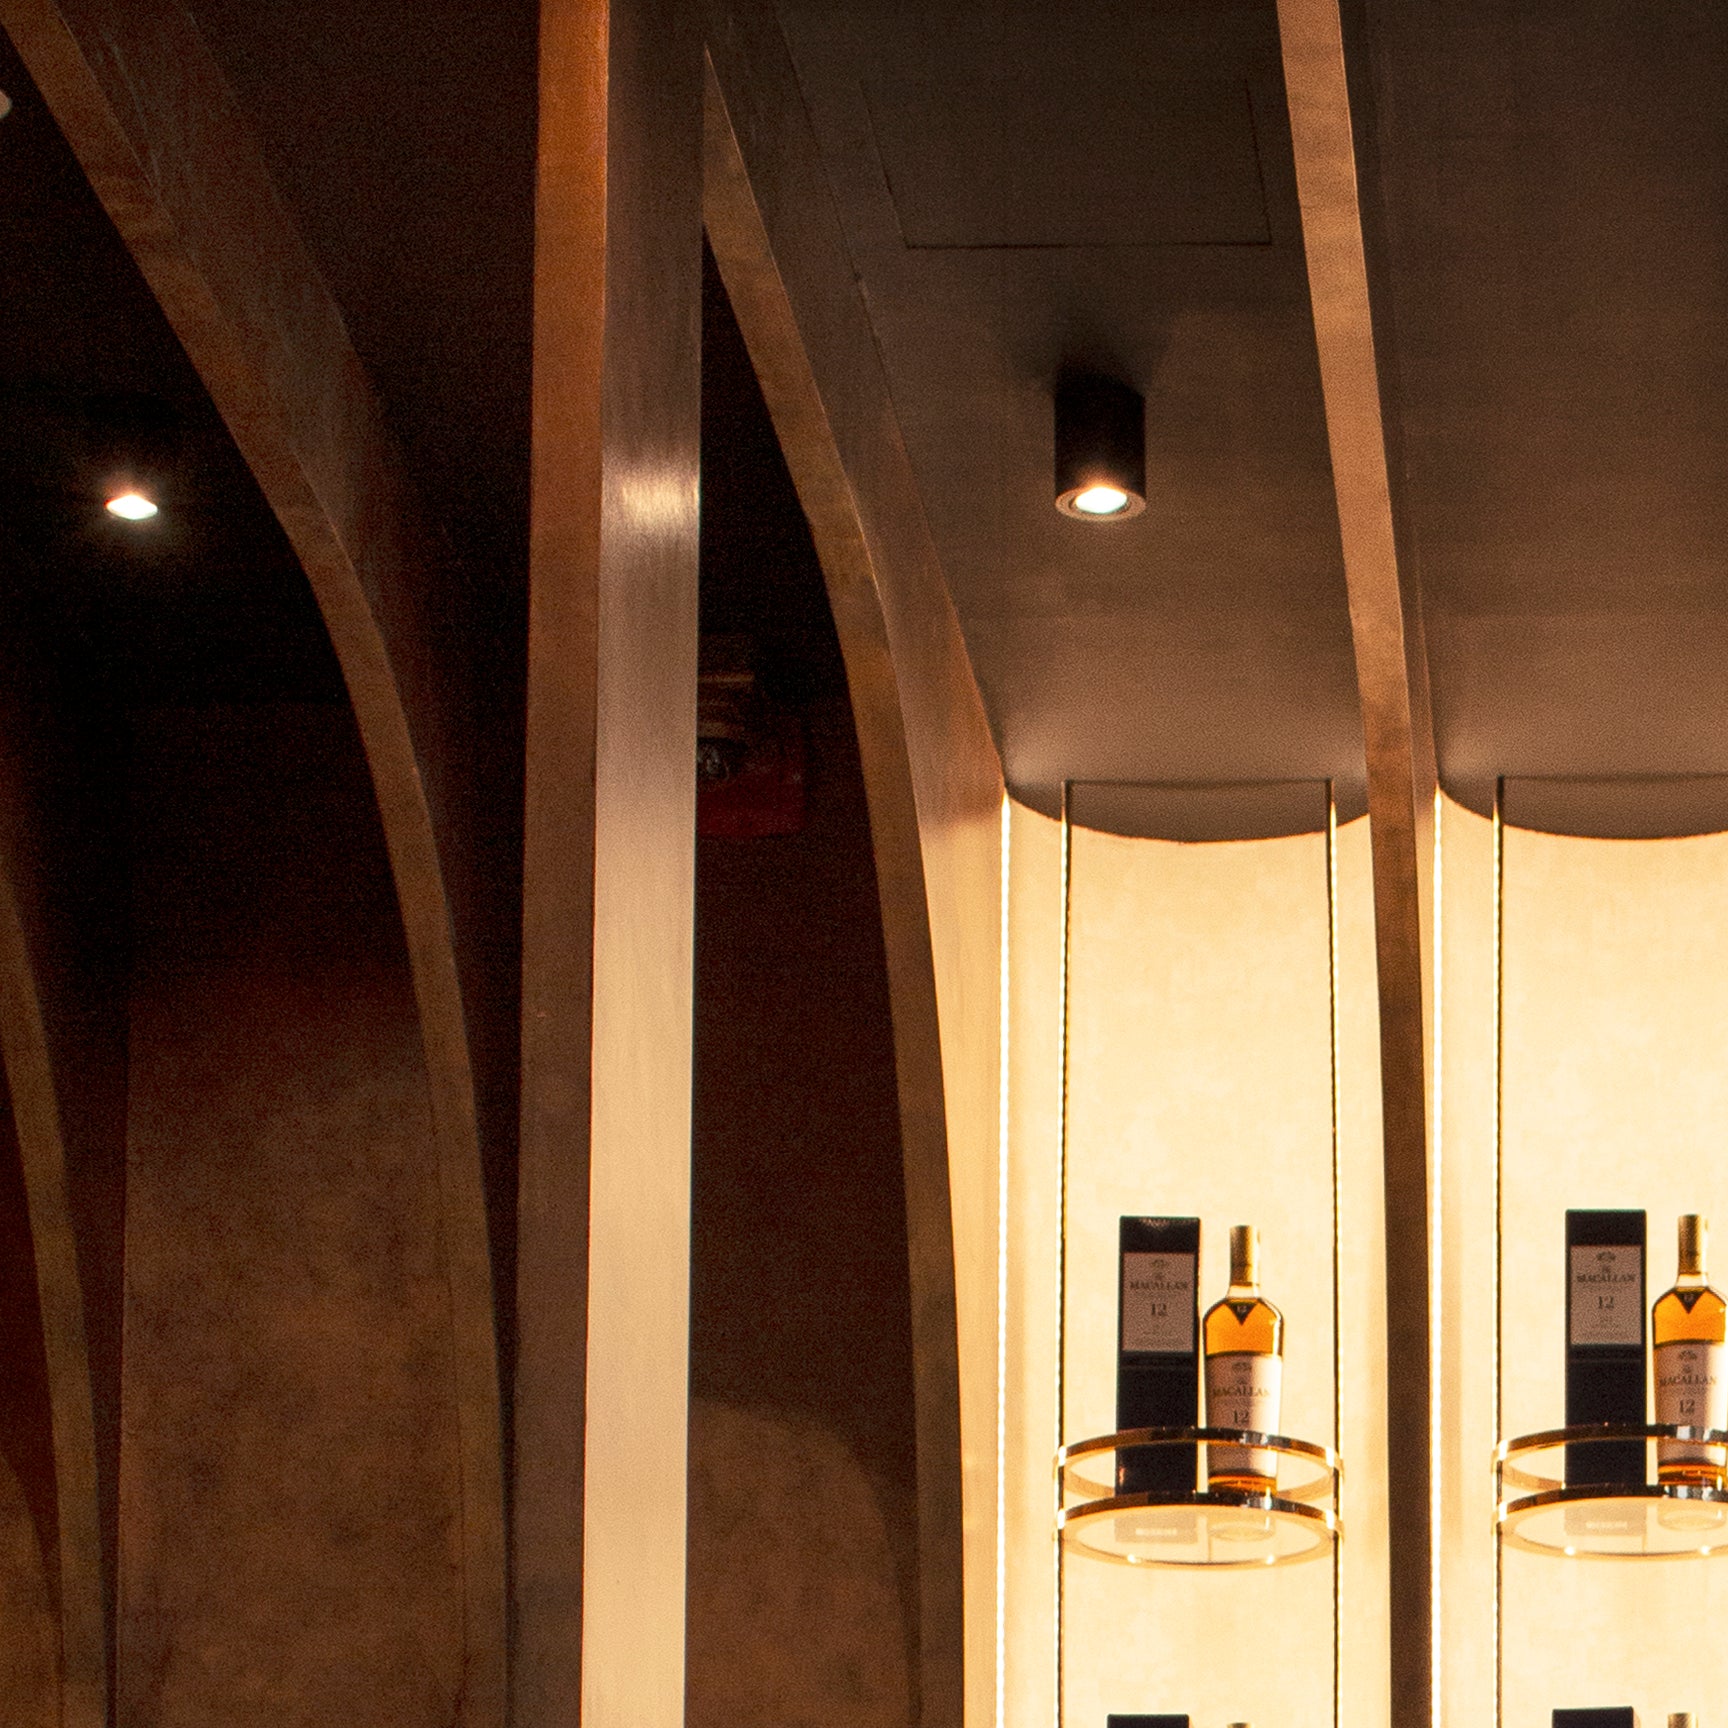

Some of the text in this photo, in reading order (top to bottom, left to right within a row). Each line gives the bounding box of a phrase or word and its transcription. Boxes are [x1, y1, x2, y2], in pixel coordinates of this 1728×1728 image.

[1598, 1296, 1614, 1309] 12
[1151, 1303, 1167, 1316] 12
[1679, 1400, 1695, 1414] 12
[1233, 1410, 1249, 1423] 12
